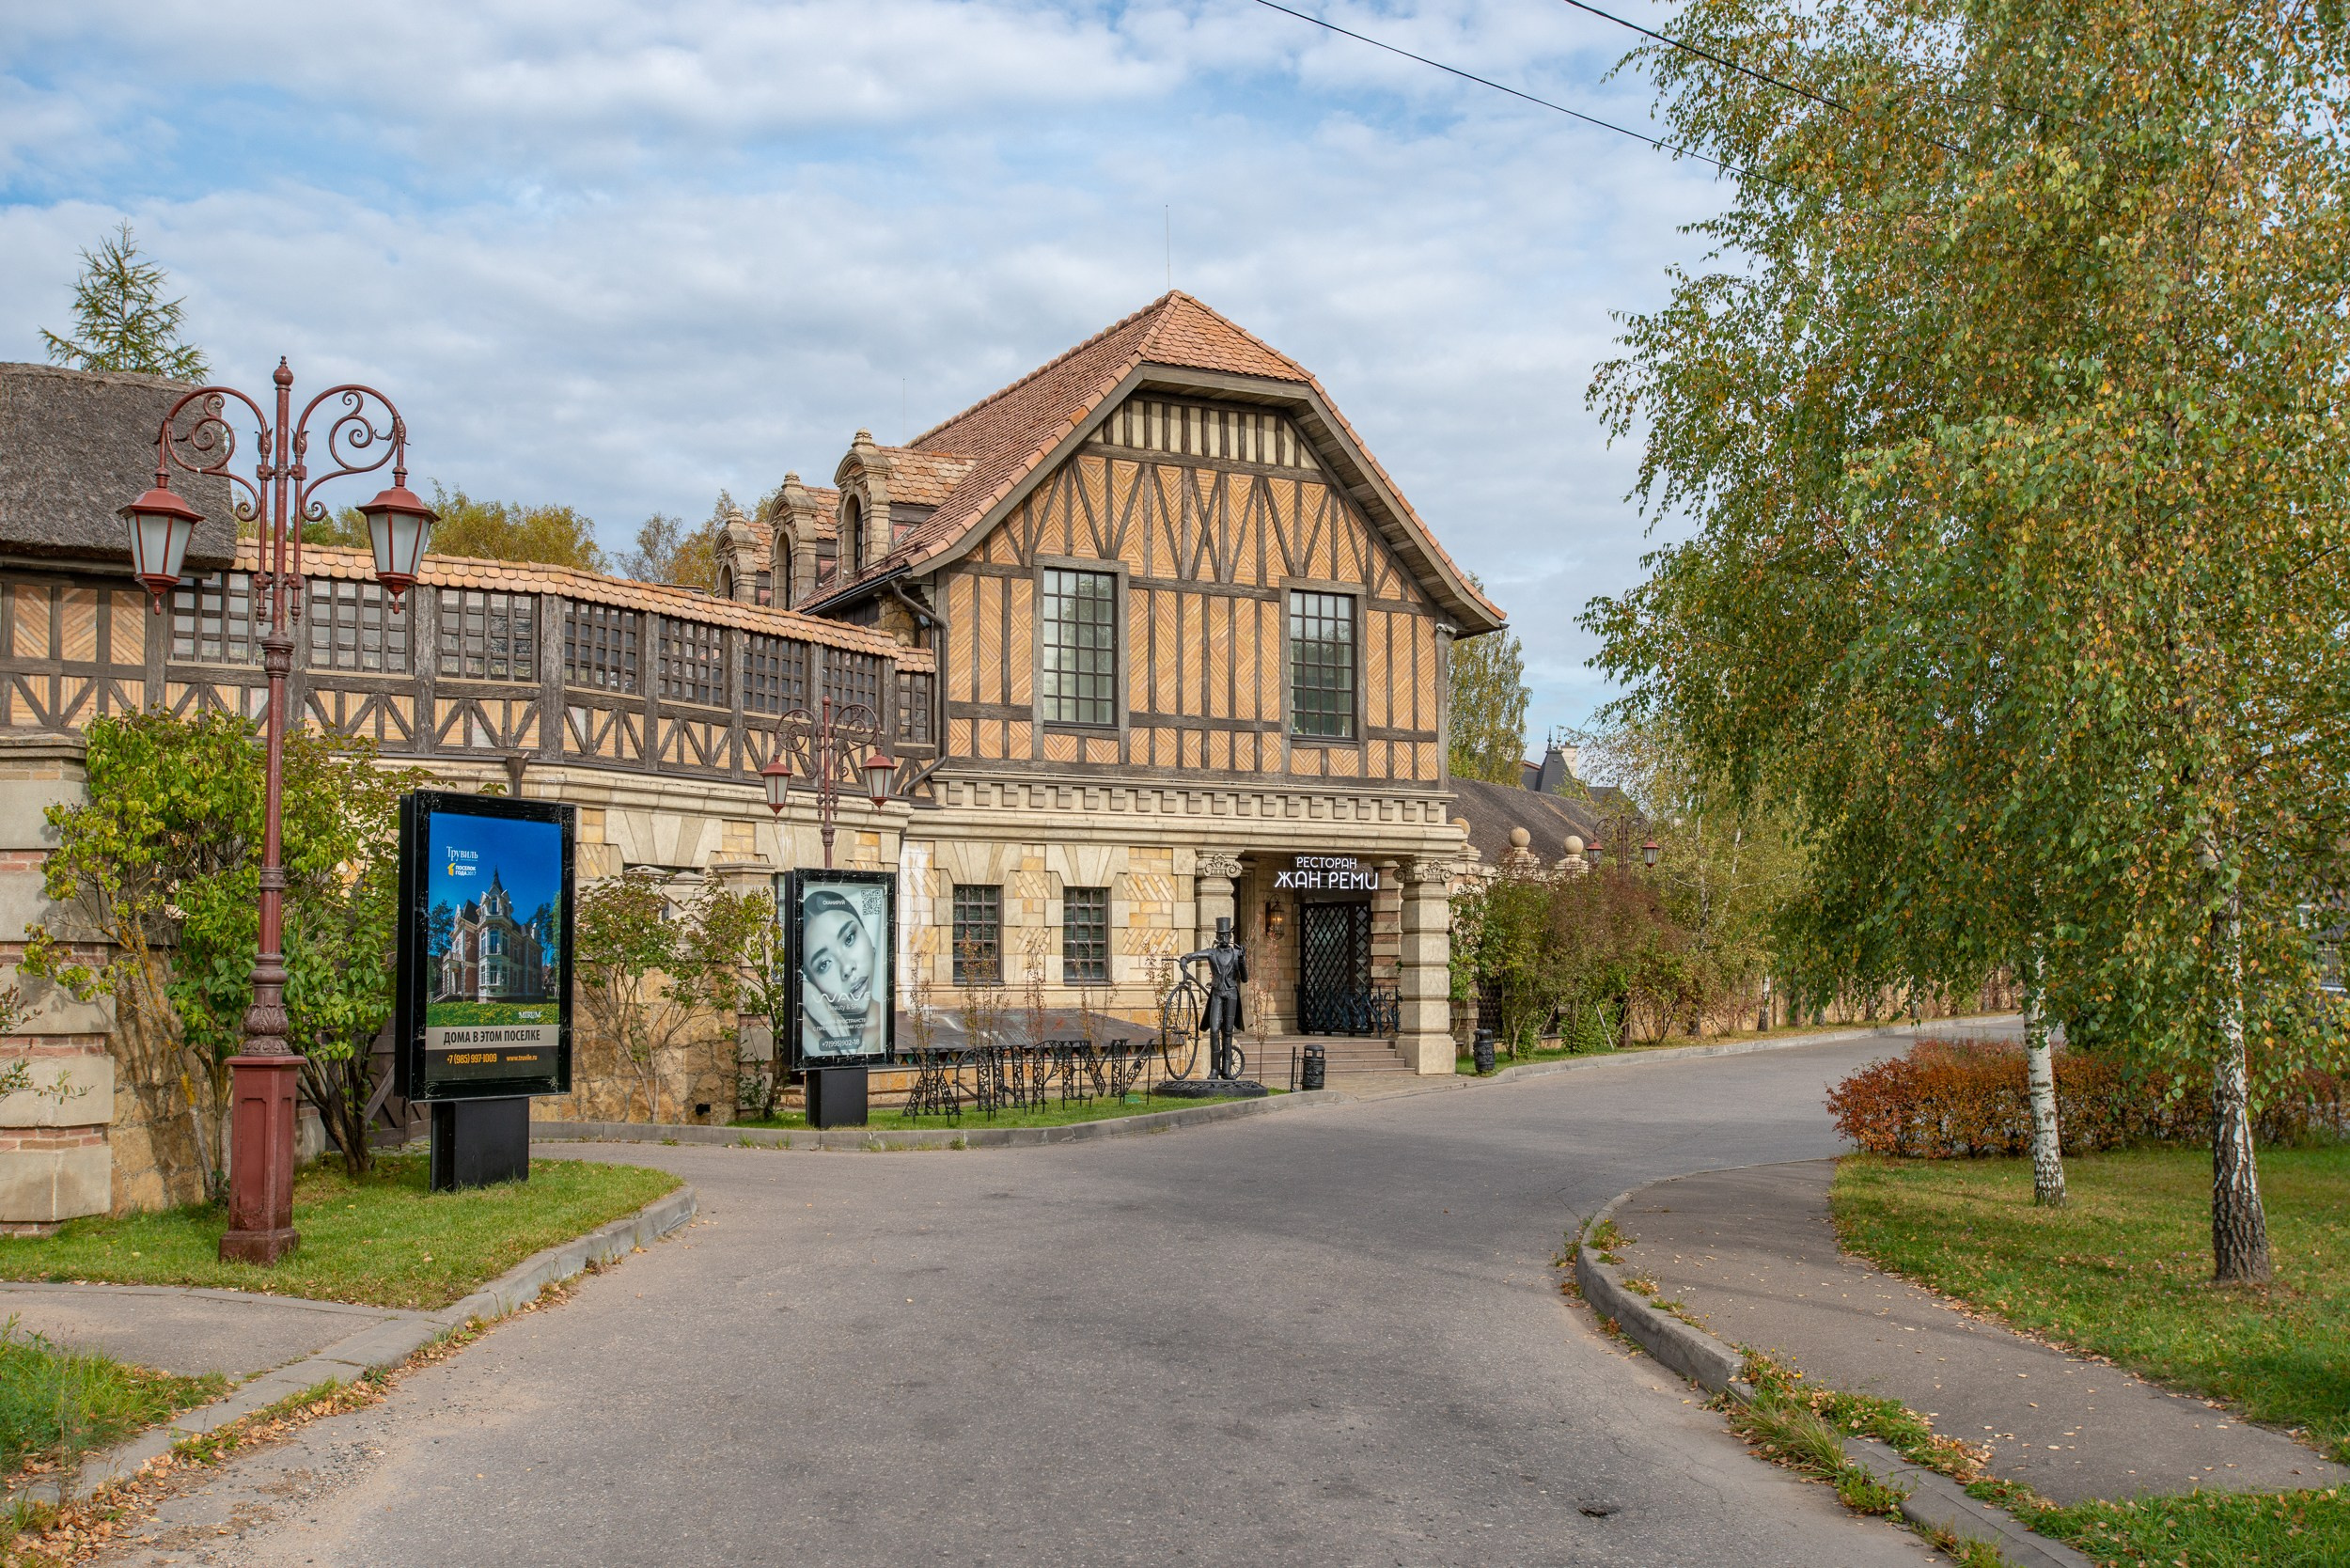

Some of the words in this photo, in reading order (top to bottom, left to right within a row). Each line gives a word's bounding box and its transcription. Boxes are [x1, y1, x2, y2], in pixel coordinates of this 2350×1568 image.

[446, 846, 478, 861] Трувиль
[1295, 856, 1357, 870] РЕСТОРАН
[1274, 870, 1321, 889] ЖАН
[1328, 871, 1379, 890] РЕМИ
[811, 991, 871, 1004] WAVE
[443, 1031, 471, 1045] ДОМА
[473, 1030, 478, 1043] В
[480, 1030, 502, 1043] ЭТОМ
[504, 1029, 540, 1042] ПОСЕЛКЕ
[446, 1055, 453, 1064] +7
[453, 1054, 471, 1064] (985)
[470, 1053, 497, 1063] 997-1009
